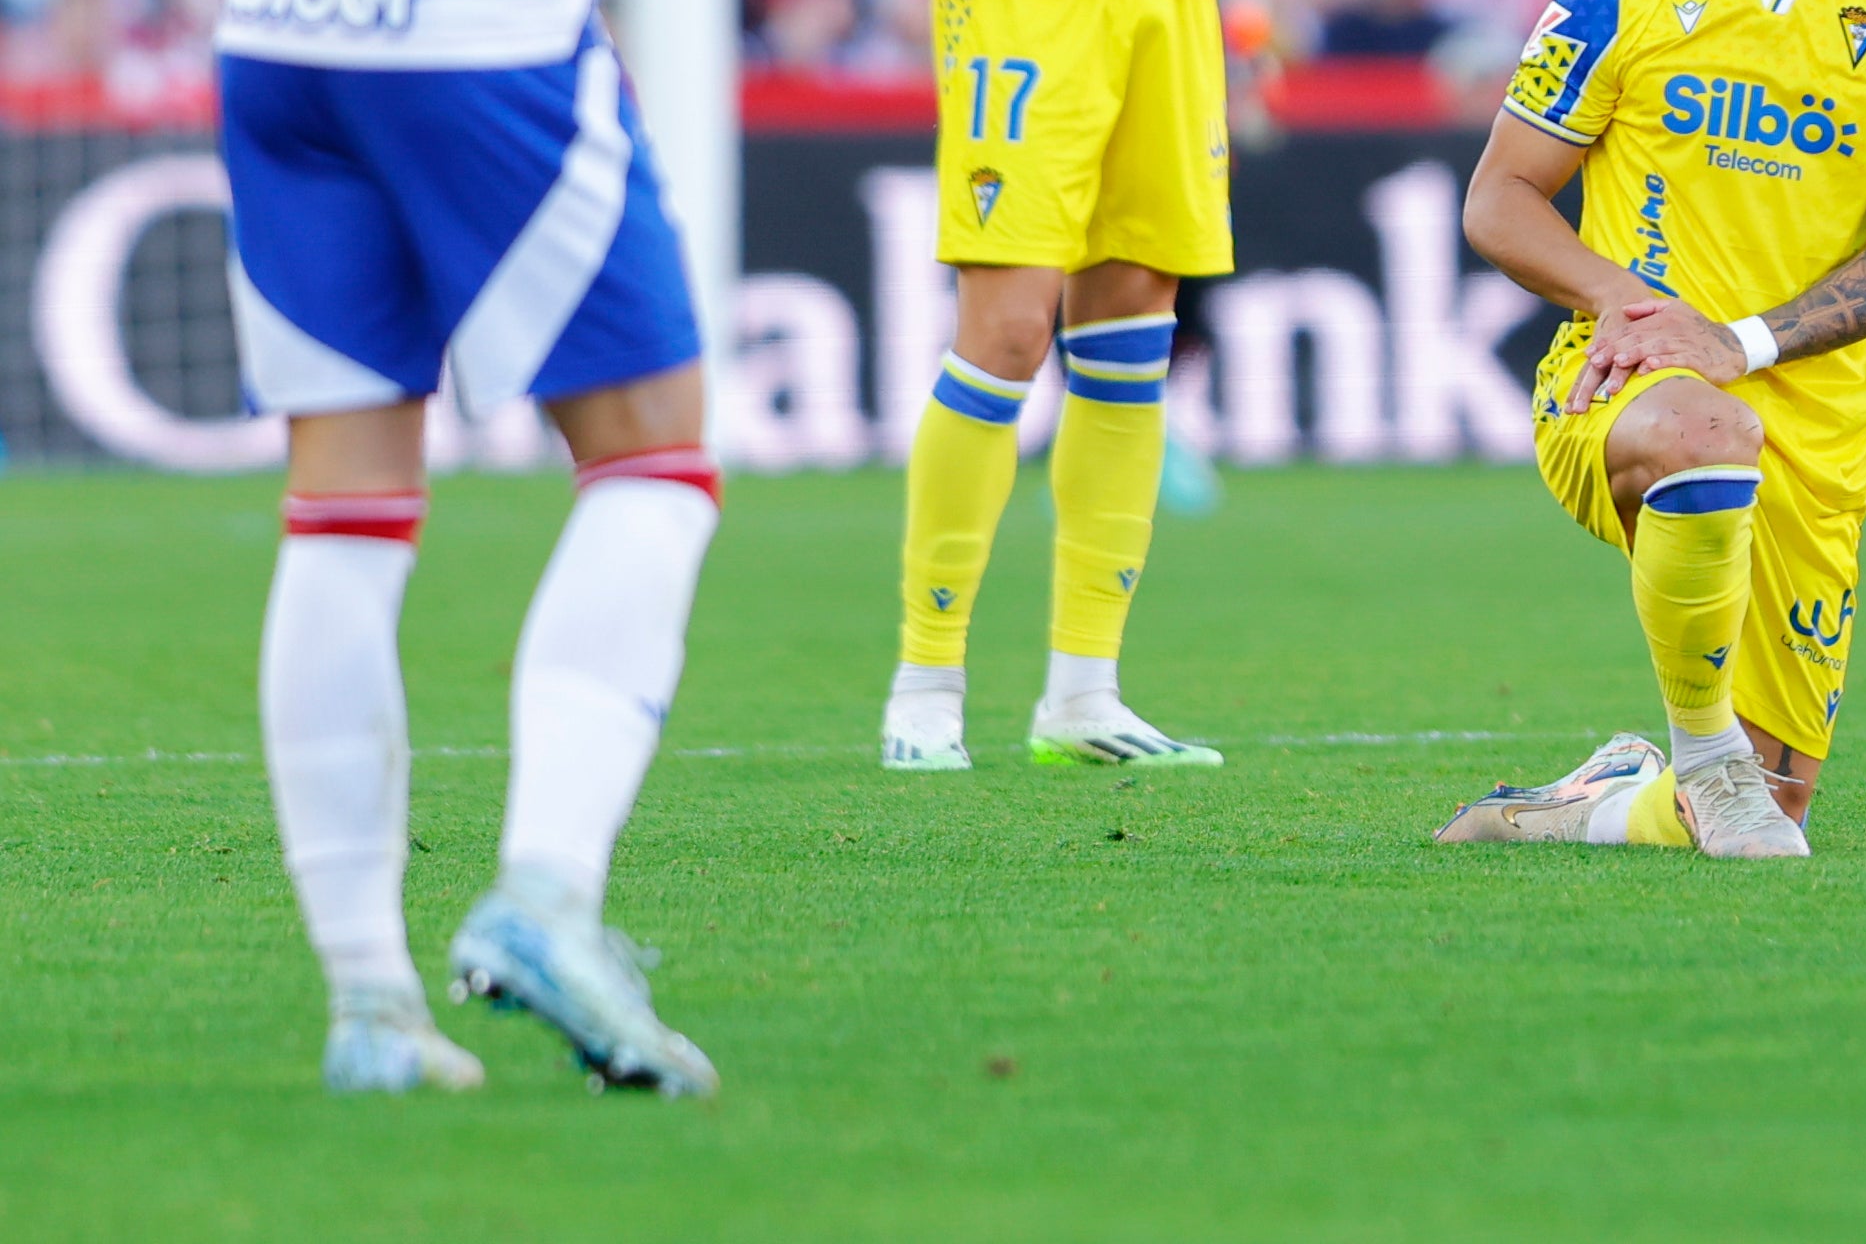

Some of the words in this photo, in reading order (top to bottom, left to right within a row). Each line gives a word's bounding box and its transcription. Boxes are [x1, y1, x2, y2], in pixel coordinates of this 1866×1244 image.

[969, 58, 1041, 141] 17
[1662, 74, 1836, 154] Silbö
[1705, 144, 1802, 181] Telecom
